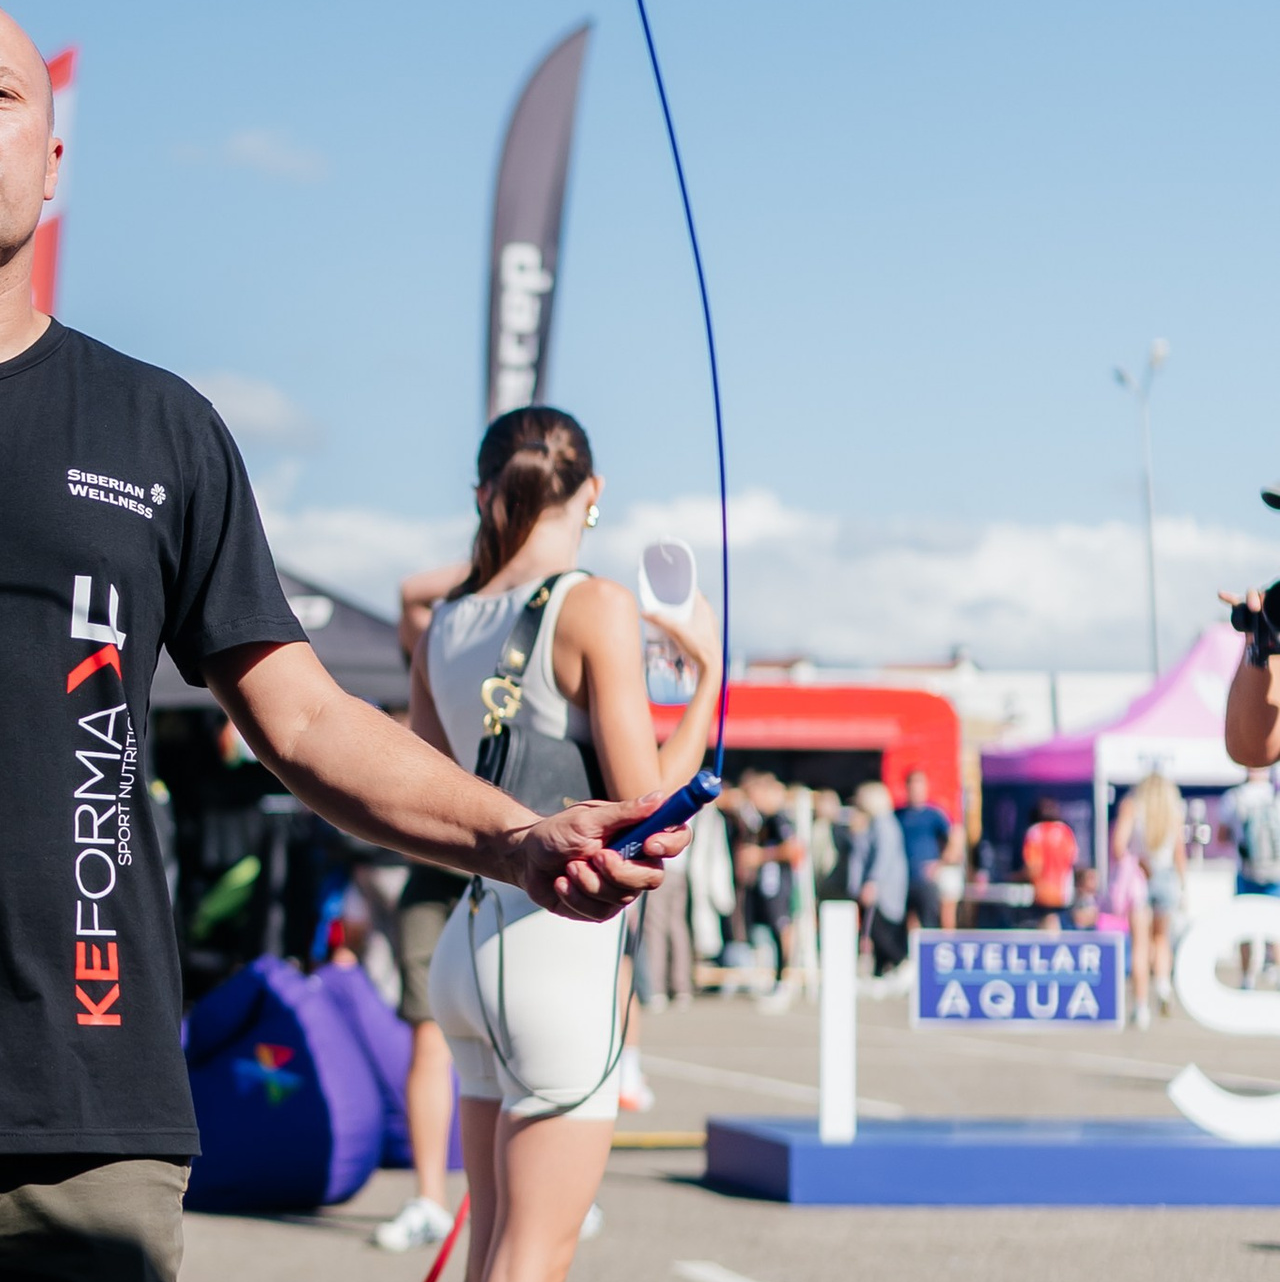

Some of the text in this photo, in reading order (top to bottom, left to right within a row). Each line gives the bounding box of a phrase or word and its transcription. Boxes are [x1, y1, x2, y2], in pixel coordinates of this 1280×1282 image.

[67, 469, 145, 499] SIBERIAN
[67, 483, 154, 519] WELLNESS
[117, 713, 137, 866] SPORT NUTRITI
[934, 942, 1101, 974] STELLAR
[936, 979, 1100, 1019] AQUA
